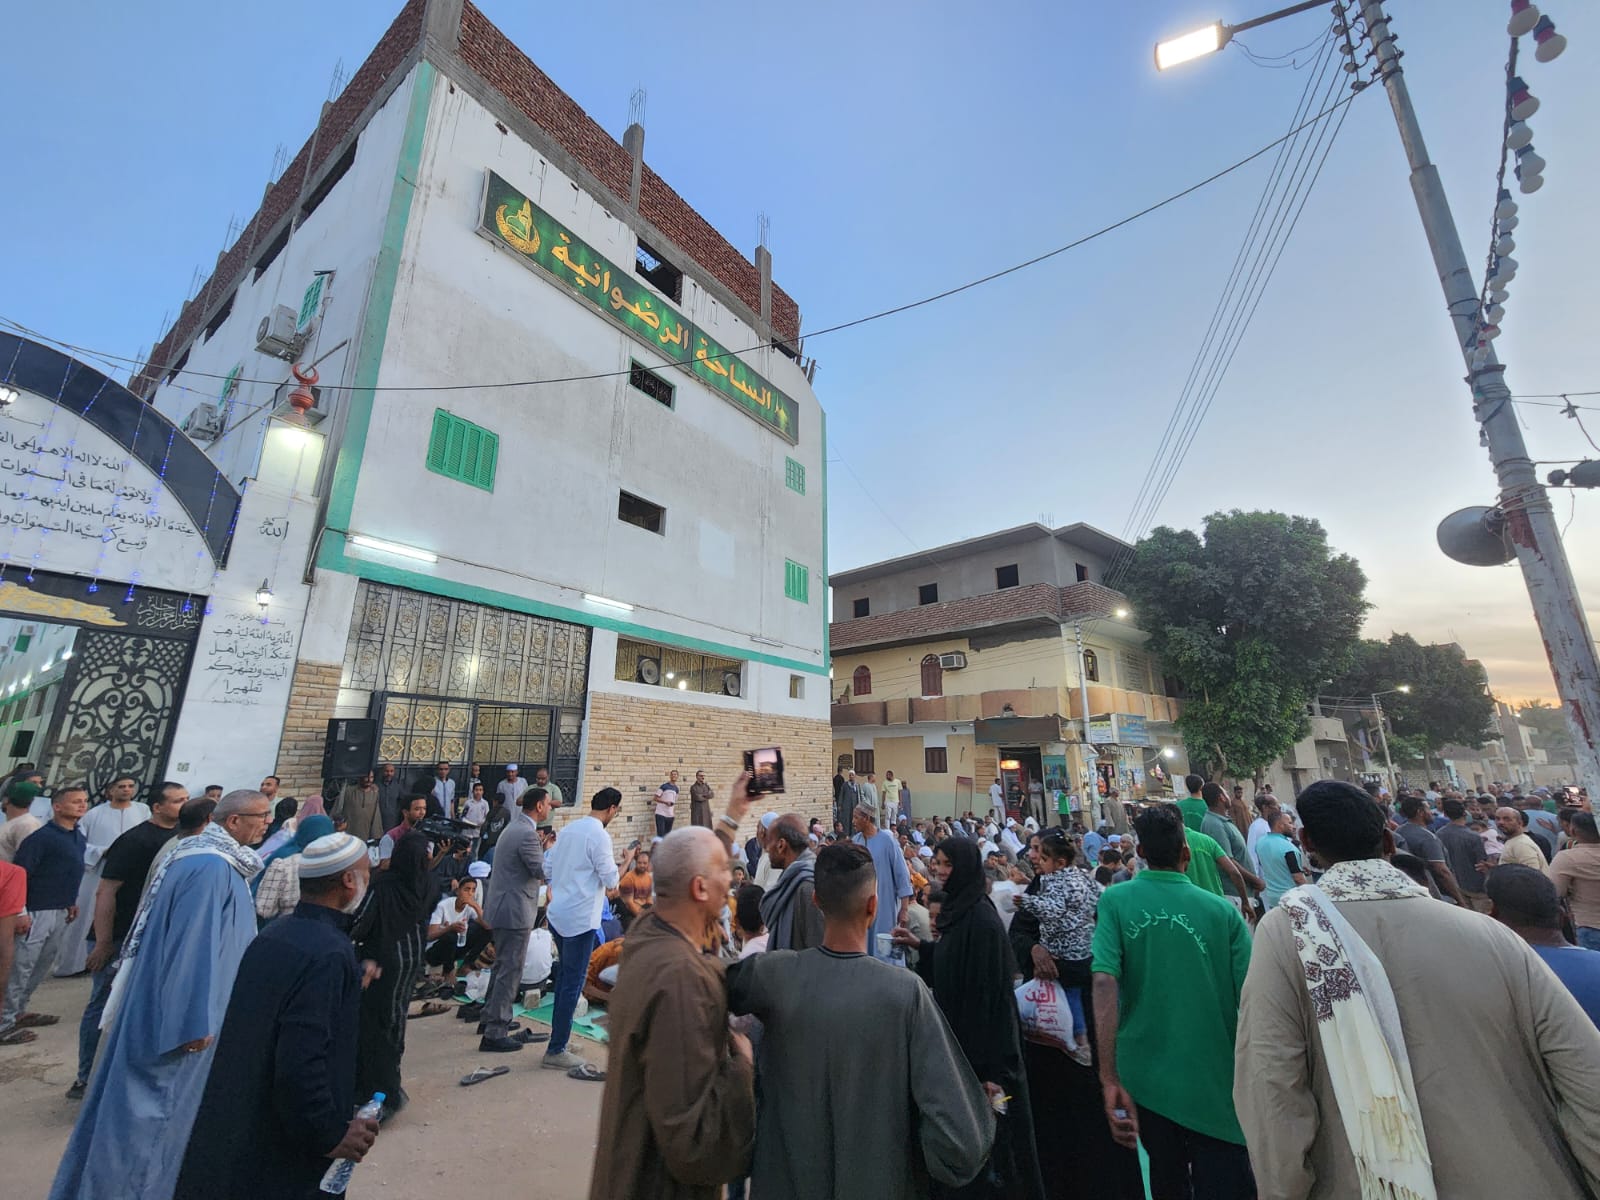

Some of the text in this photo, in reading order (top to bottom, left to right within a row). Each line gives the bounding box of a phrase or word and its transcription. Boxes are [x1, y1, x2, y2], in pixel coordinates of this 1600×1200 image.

[551, 232, 772, 410] الساحة الرضوانية
[103, 457, 124, 473] الله
[91, 477, 103, 491] ما
[258, 517, 289, 541] الله
[116, 538, 147, 552] وسع
[249, 629, 266, 640] الله
[1139, 908, 1168, 928] شرف
